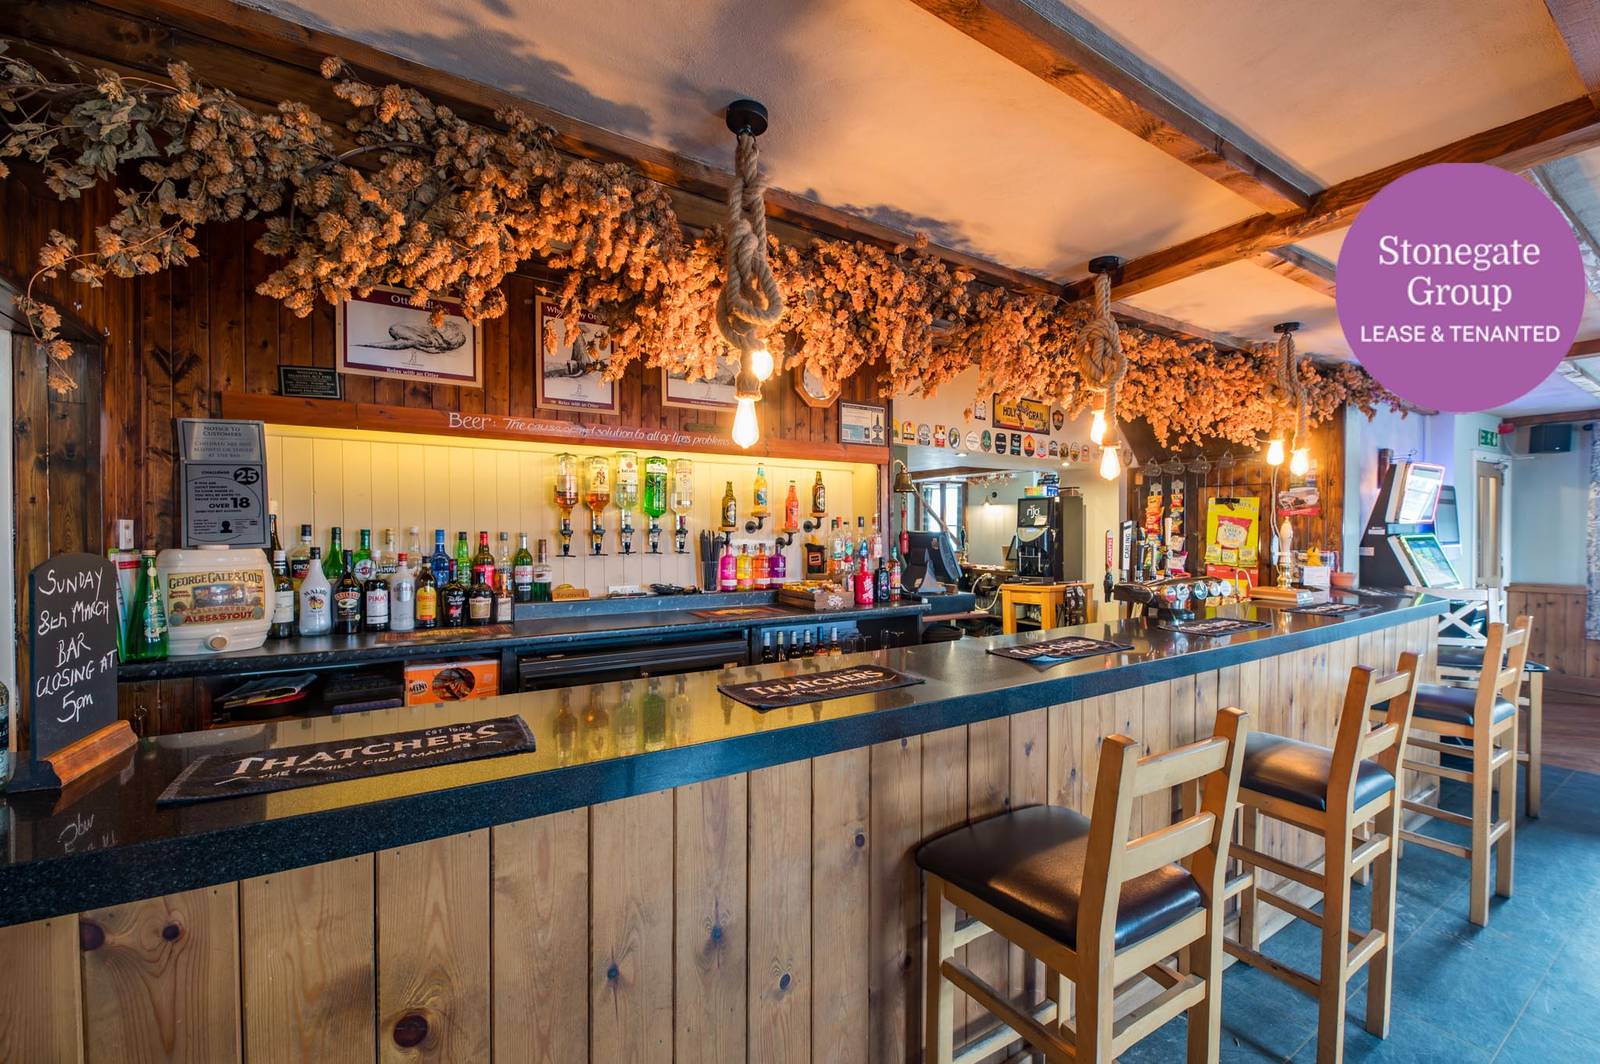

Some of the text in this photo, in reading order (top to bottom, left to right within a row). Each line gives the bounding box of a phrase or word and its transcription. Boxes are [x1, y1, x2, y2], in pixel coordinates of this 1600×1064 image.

[1002, 406, 1016, 416] HOLY
[1028, 409, 1043, 420] GRAIL
[503, 417, 526, 431] The
[597, 427, 634, 439] solution
[635, 429, 645, 440] to
[647, 431, 660, 441] all
[660, 433, 672, 443] of
[692, 434, 730, 447] problems
[236, 469, 257, 481] 25
[230, 497, 250, 509] 18
[39, 567, 103, 601] SUNDAY
[169, 573, 207, 589] GEORGE
[207, 572, 233, 584] GALE
[38, 600, 109, 636] 8th MARCH
[184, 614, 212, 623] ALES
[56, 632, 91, 668] BAR
[36, 649, 117, 697] CLOSING AT
[745, 670, 885, 696] THATCHERS
[57, 690, 93, 723] 5pm
[232, 724, 499, 775] THATCHERS
[257, 742, 471, 779] THE FAMILY CIDER MAKERS
